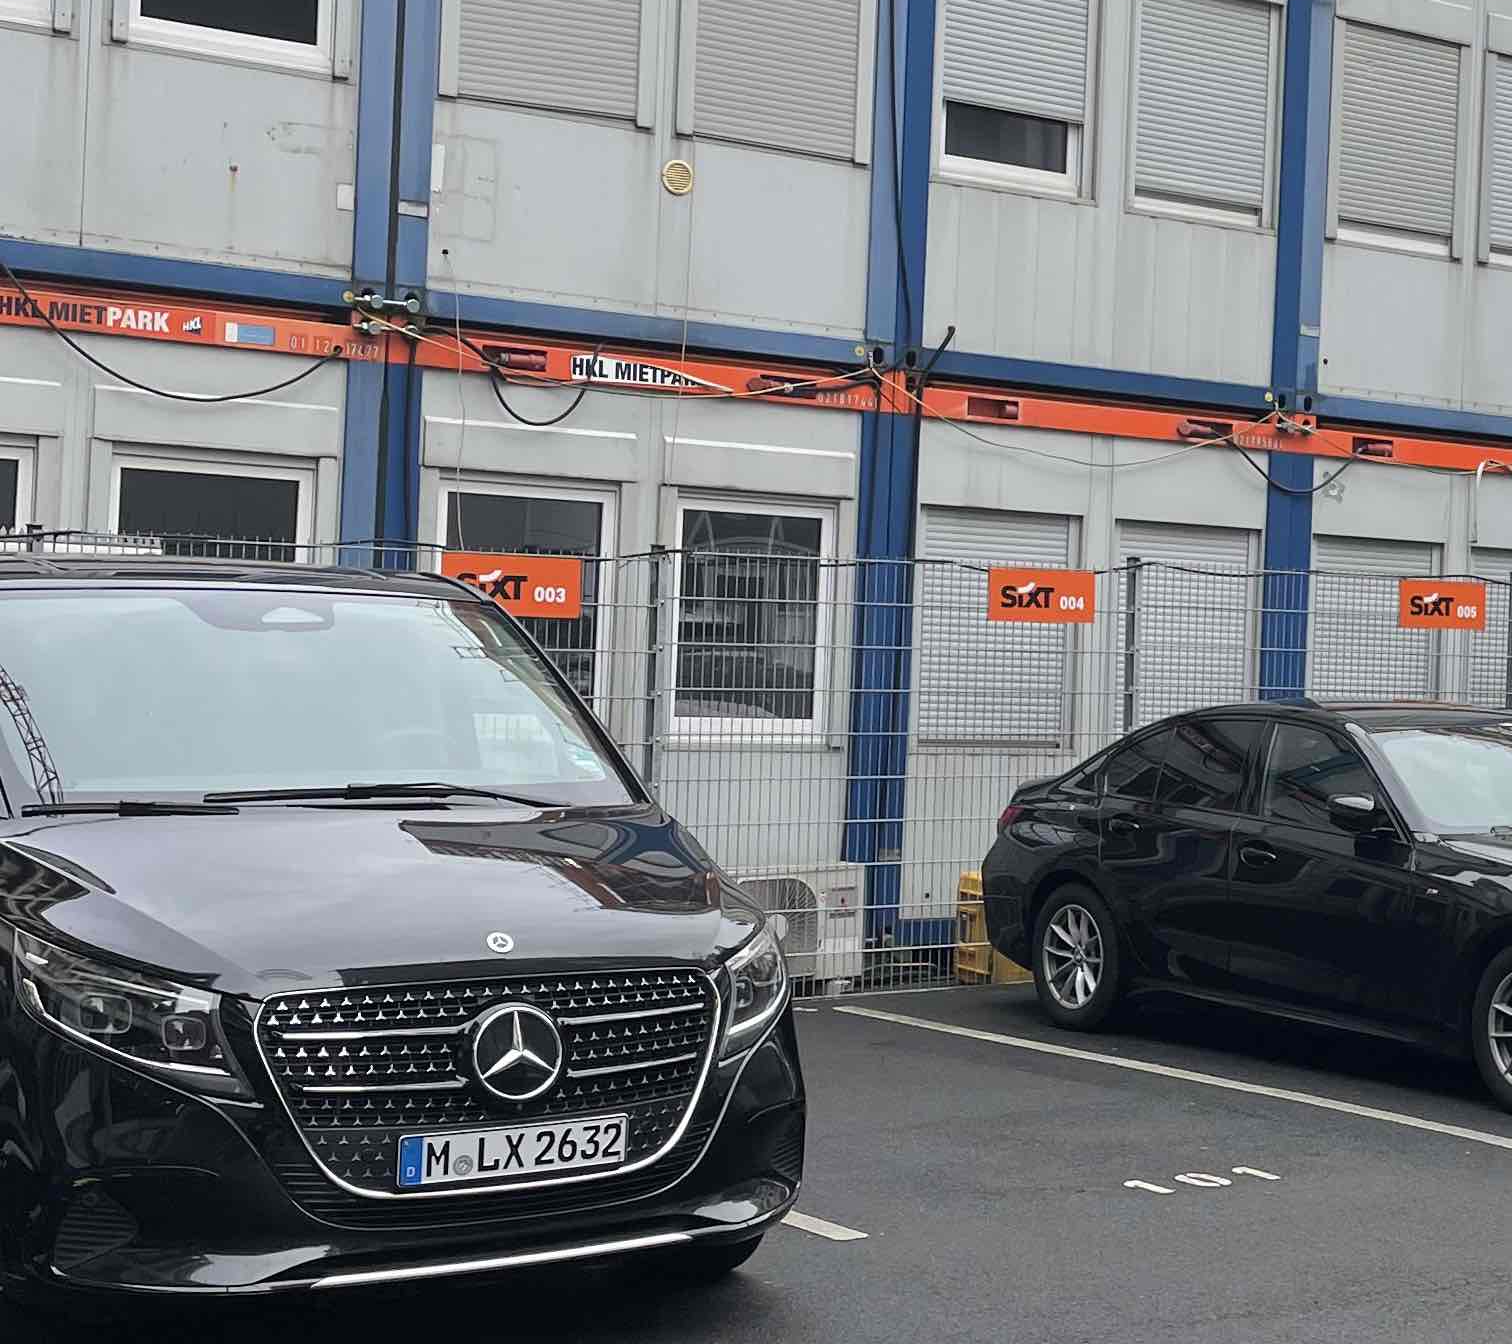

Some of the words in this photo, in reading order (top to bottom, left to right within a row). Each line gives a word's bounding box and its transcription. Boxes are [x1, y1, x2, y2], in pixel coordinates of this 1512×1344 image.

[0, 295, 41, 319] HKL
[48, 301, 170, 333] MIETPARK
[572, 357, 609, 378] HKL
[534, 586, 566, 603] 003
[1000, 582, 1056, 608] SIXT
[1060, 596, 1085, 610] 004
[1410, 592, 1455, 616] SIXT
[1457, 606, 1477, 619] 005
[406, 1166, 417, 1178] D
[425, 1140, 451, 1177] M
[478, 1132, 526, 1172] LX
[534, 1122, 623, 1166] 2632
